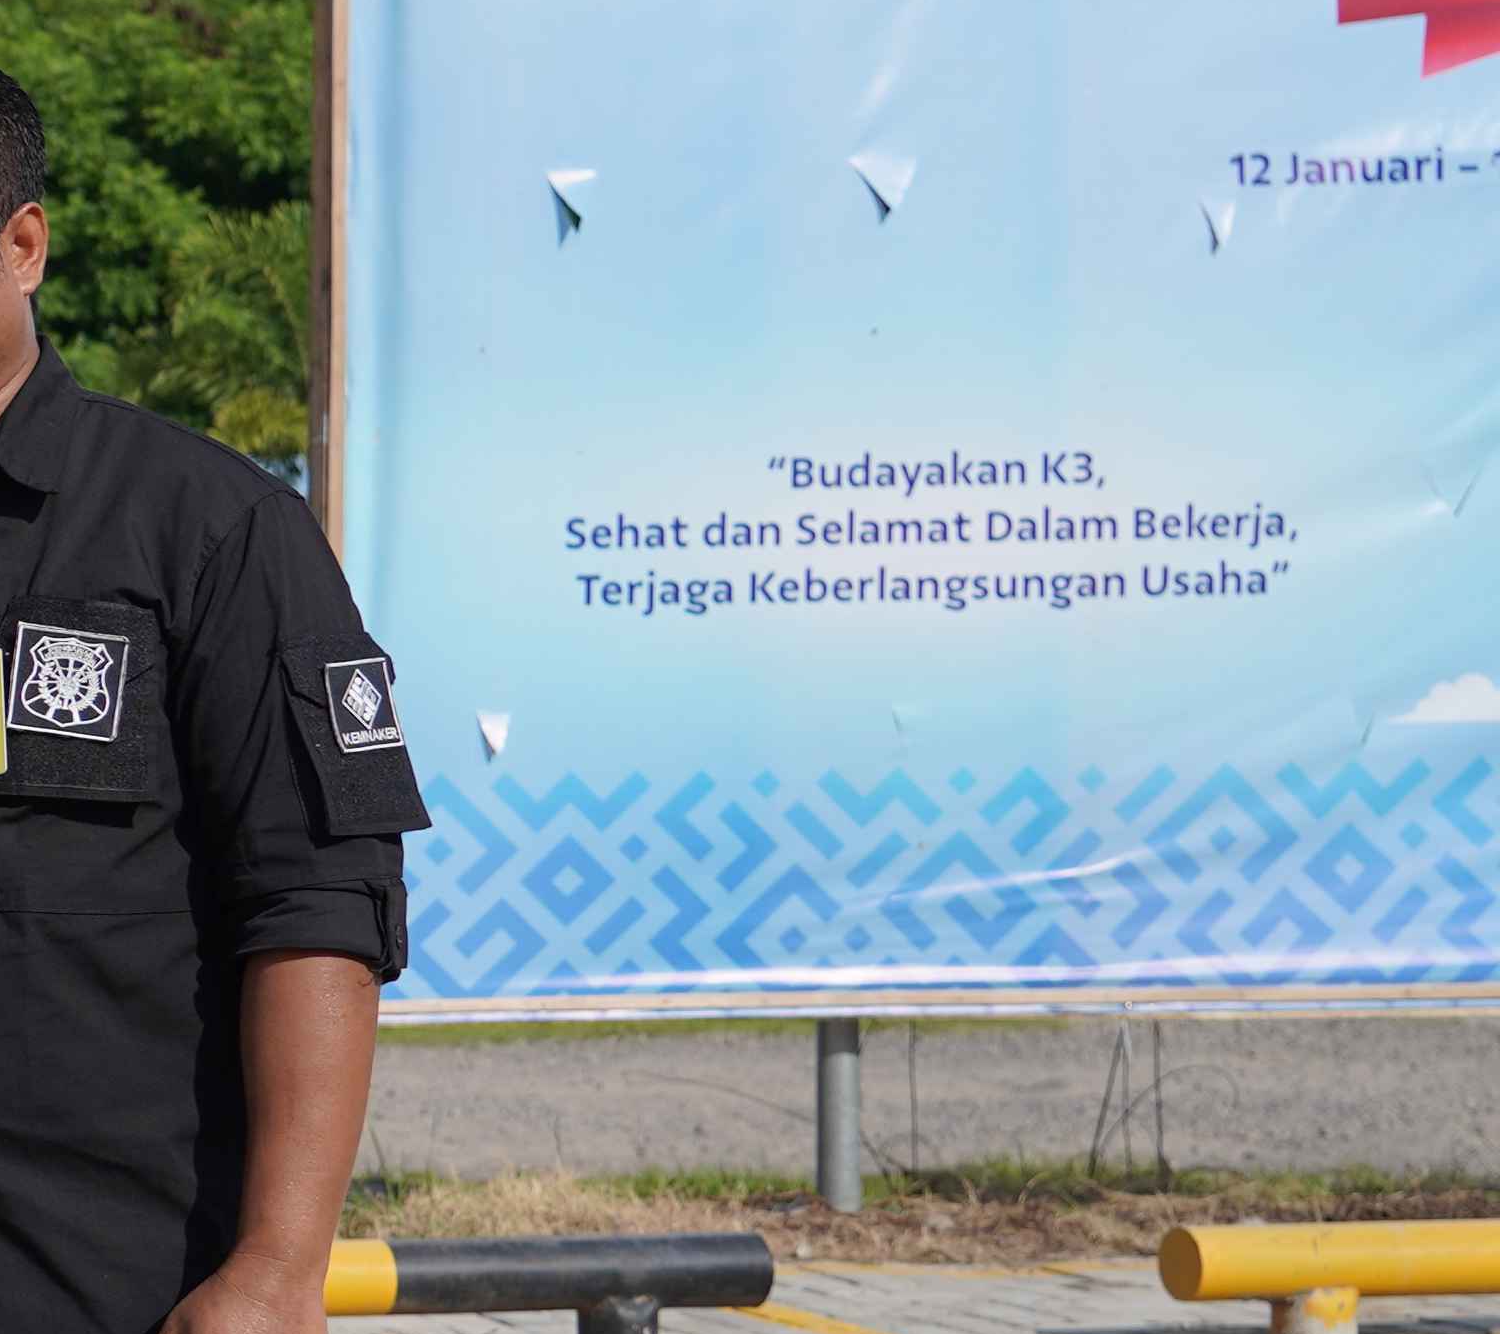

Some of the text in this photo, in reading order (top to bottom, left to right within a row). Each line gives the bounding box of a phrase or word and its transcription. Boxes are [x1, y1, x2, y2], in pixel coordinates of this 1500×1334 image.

[1230, 153, 1271, 185] 12
[1284, 146, 1444, 185] Januari
[1041, 452, 1105, 488] K3,
[565, 503, 1298, 550] Sehat dan Selamat Dalam Bekerja,
[576, 570, 733, 616] Terjaga
[751, 566, 1126, 610] Keberlangsungan
[342, 727, 399, 745] KEMNAKER
